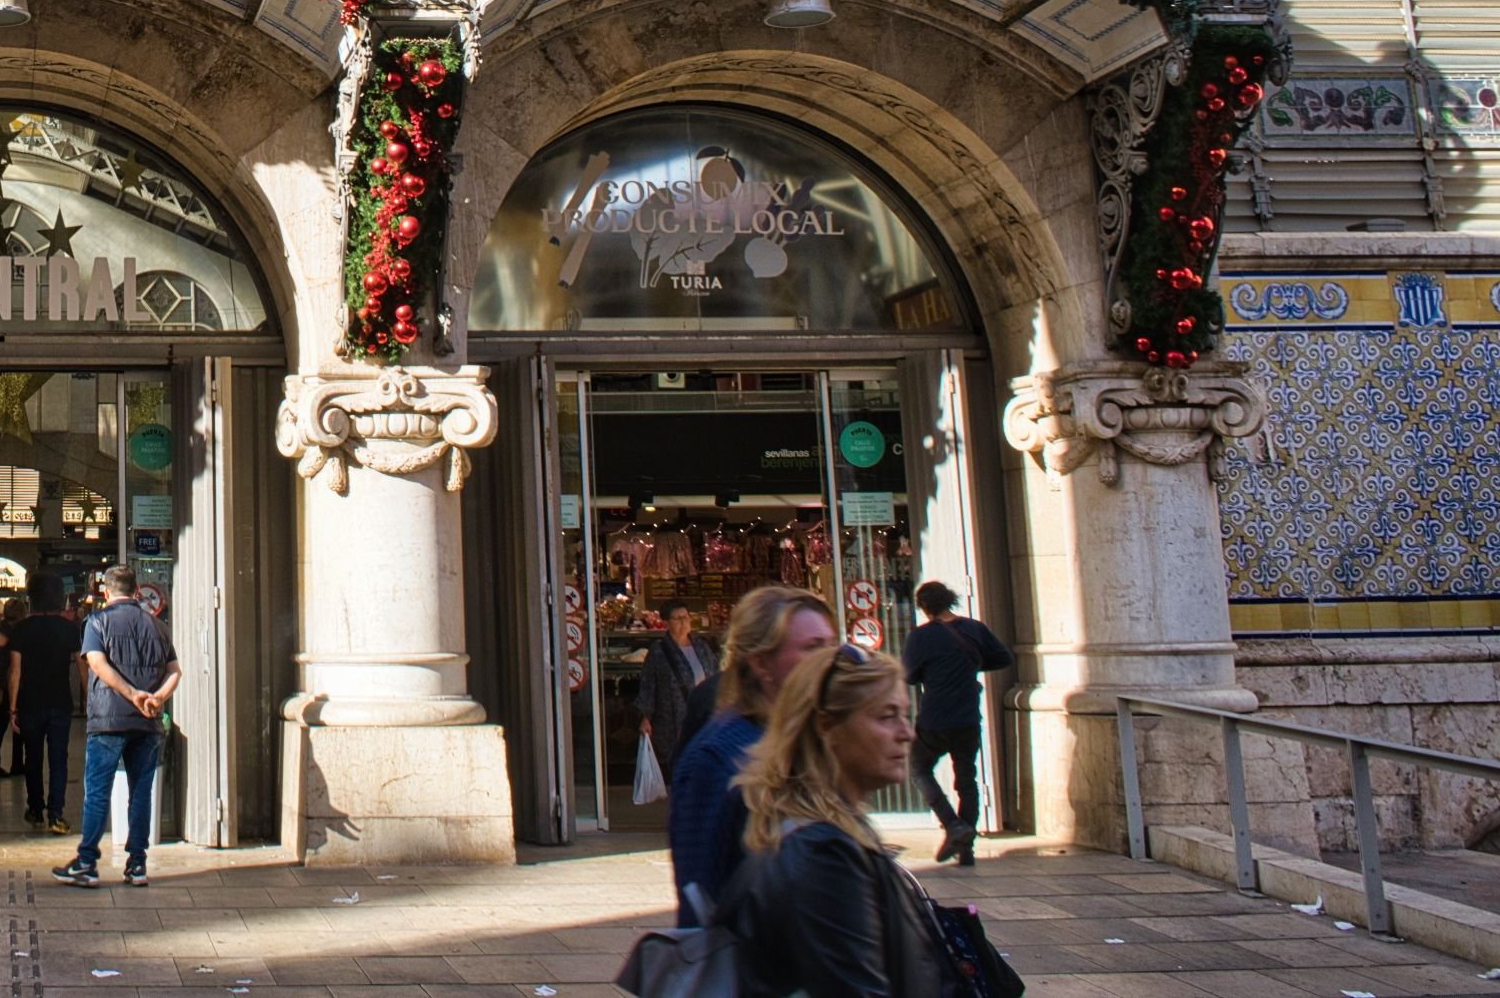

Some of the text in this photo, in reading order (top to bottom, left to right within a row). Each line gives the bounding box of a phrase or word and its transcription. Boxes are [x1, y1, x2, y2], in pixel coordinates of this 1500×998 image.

[600, 179, 787, 207] CONSUMIX
[542, 208, 845, 236] PRODUCTE LOCAL
[670, 275, 723, 290] TURIA
[764, 449, 810, 459] sevillanas
